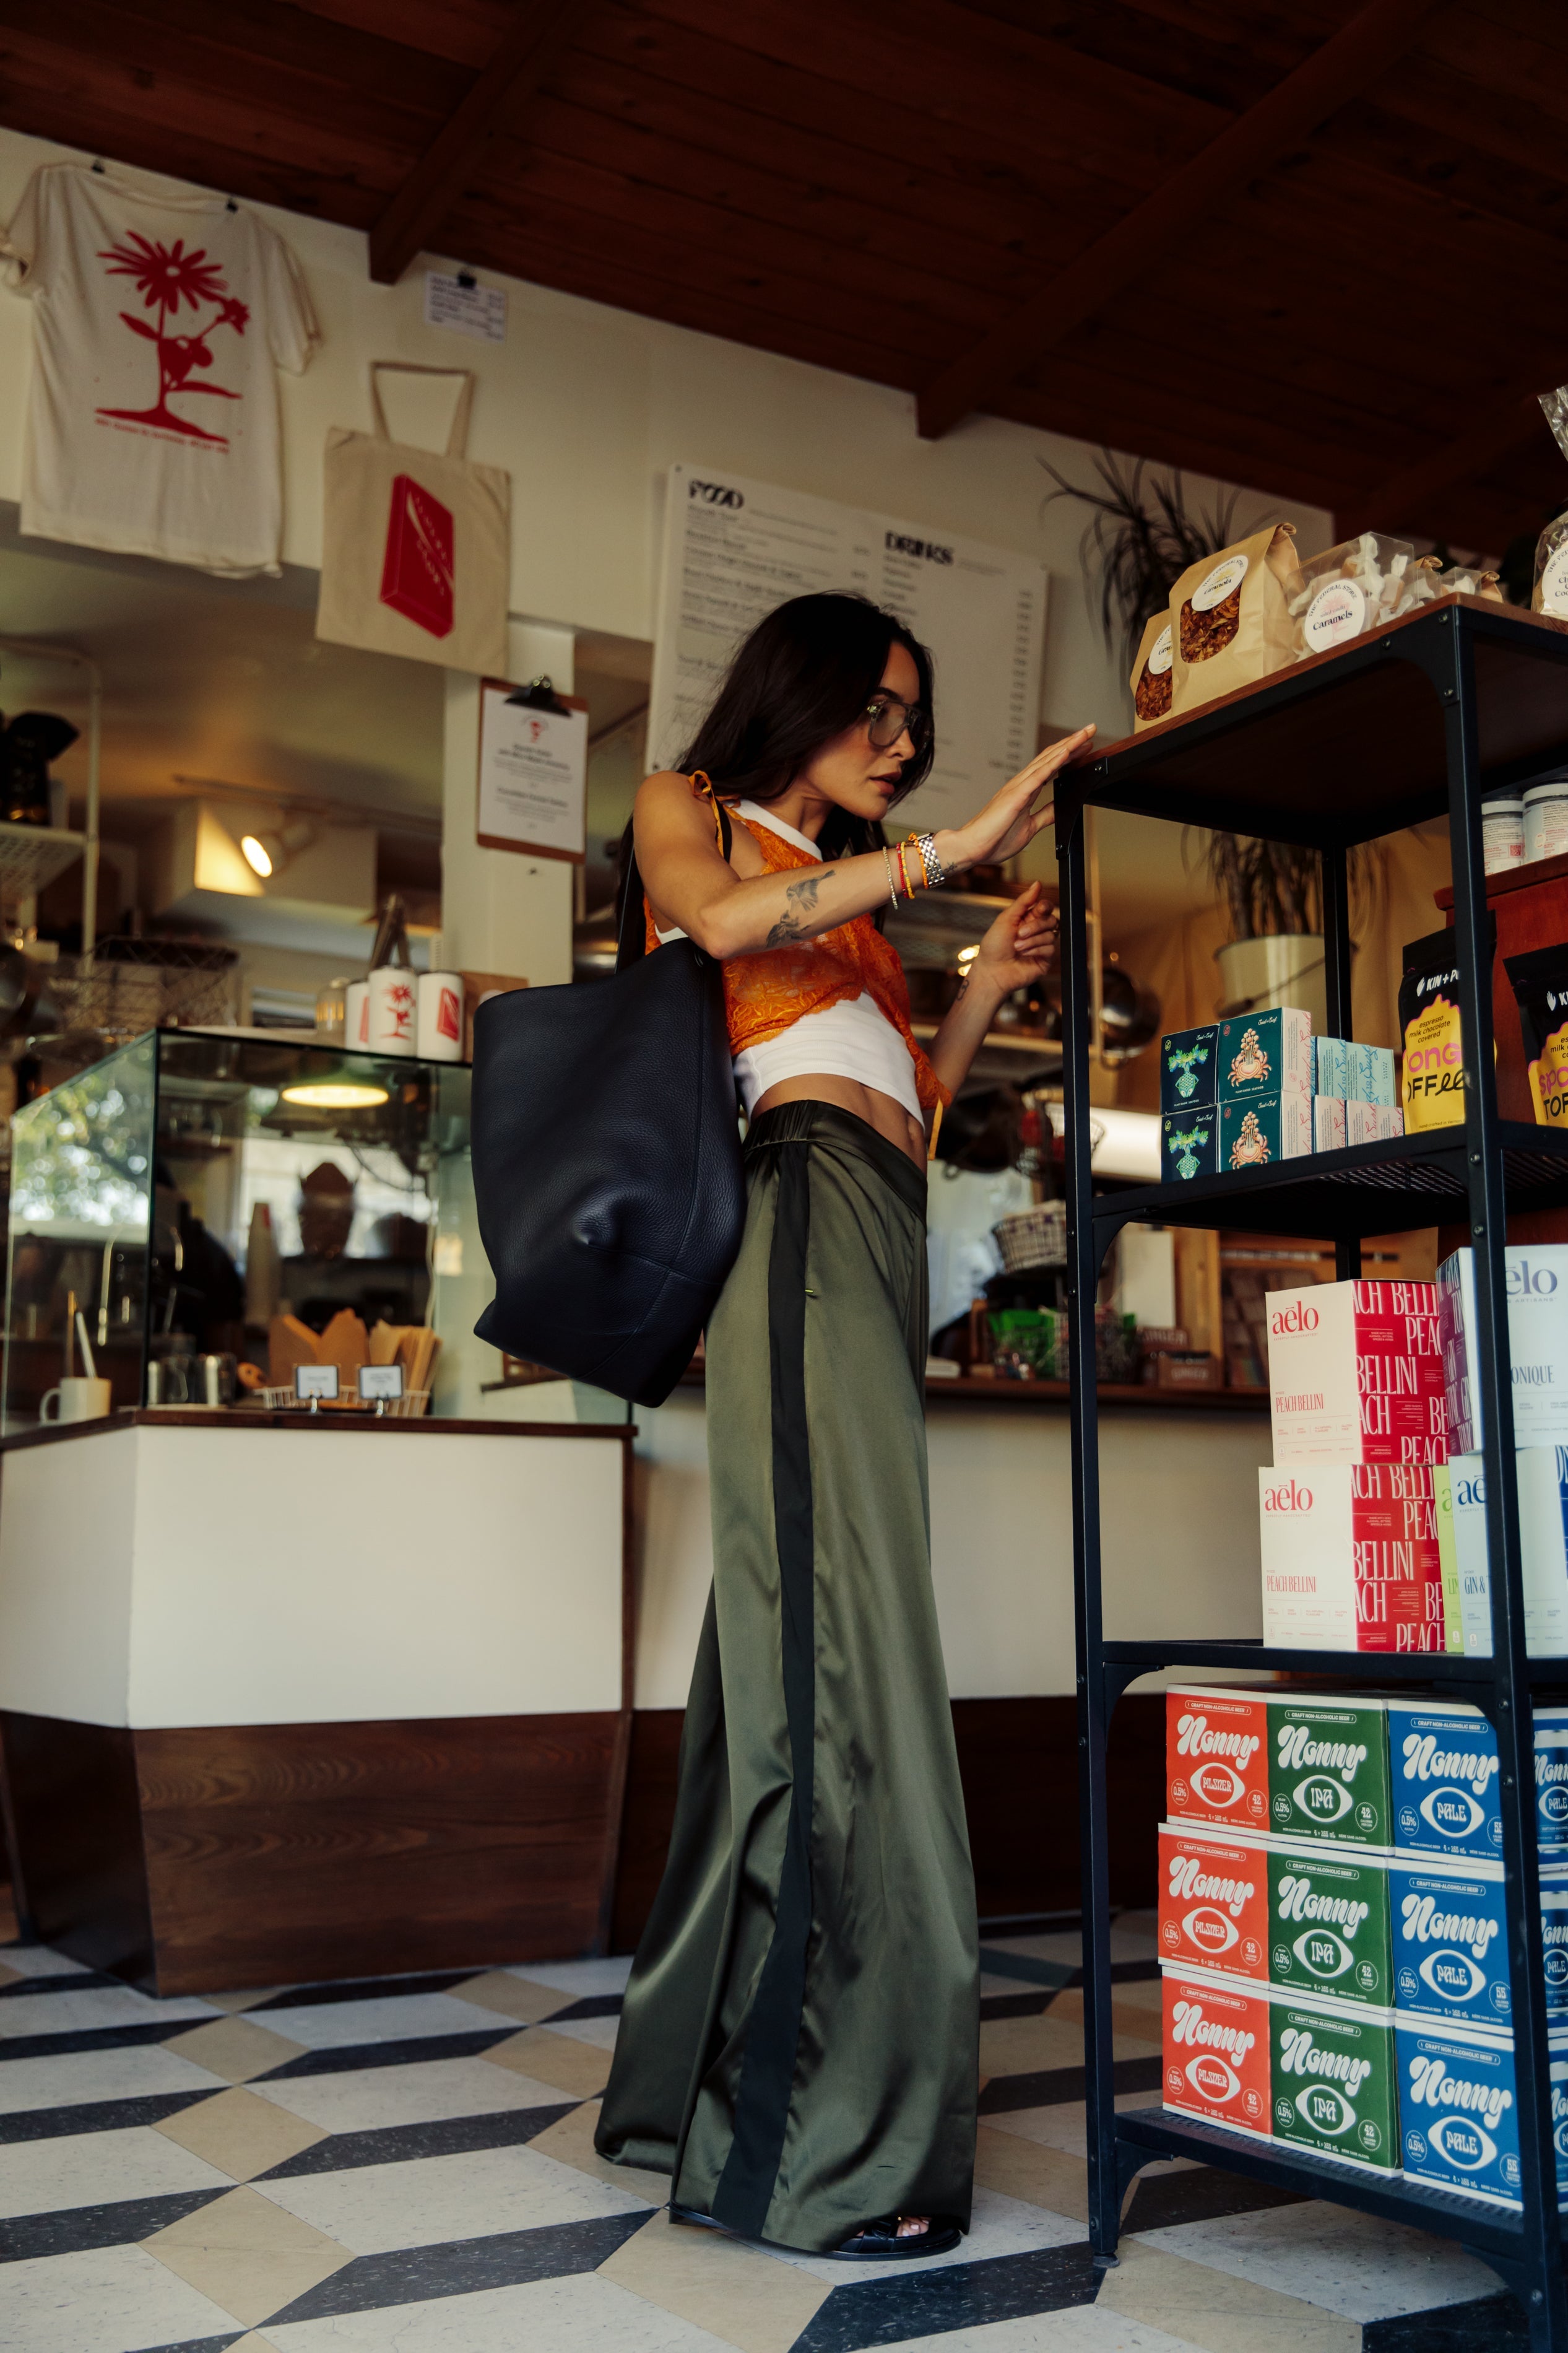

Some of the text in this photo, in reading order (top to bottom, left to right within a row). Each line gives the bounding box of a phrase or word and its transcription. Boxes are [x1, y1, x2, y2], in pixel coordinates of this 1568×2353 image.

[689, 481, 745, 510] FOOD
[885, 531, 954, 565] DRINKS
[1317, 585, 1341, 603] FEDERAL
[1343, 585, 1357, 599] STORE
[1313, 611, 1353, 630] Caramels
[1426, 975, 1442, 991] KIN
[1410, 1020, 1450, 1038] milk chocolate
[1419, 1016, 1444, 1028] espresso
[1418, 1030, 1440, 1043] covered
[1550, 1043, 1564, 1053] milk
[1505, 1260, 1557, 1295] ēlo
[1352, 1281, 1439, 1316] ACH BELLI
[1272, 1301, 1319, 1334] aēlo
[1406, 1317, 1442, 1355] PEAC
[1355, 1355, 1418, 1394] BELLINI
[1511, 1365, 1554, 1386] ONIQUE
[1276, 1393, 1323, 1412] PEACH BELLINI
[1358, 1395, 1390, 1434] ACH
[1351, 1465, 1434, 1499] ACH BELLI
[1264, 1479, 1313, 1511] aēlo
[1353, 1541, 1414, 1580] BELLINI
[1267, 1575, 1316, 1592] PEACH BELLINI
[1465, 1577, 1478, 1595] GIN
[1354, 1582, 1386, 1622] ACH
[1177, 1715, 1259, 1770] Nonny
[1278, 1725, 1366, 1782] Nonny
[1403, 1734, 1500, 1795] Nonny
[1174, 1786, 1186, 1797] 0.5%
[1203, 1777, 1232, 1792] PILSNER
[1252, 1794, 1261, 1805] 42
[1275, 1802, 1289, 1812] 0.5%
[1311, 1788, 1333, 1809] IPA
[1548, 1797, 1567, 1810] PALE
[1361, 1807, 1371, 1818] 42
[1401, 1815, 1416, 1826] 0.5%
[1437, 1802, 1466, 1822] PALE
[1197, 1846, 1228, 1856] NON-ALCOHOLIC
[1307, 1865, 1340, 1874] NON-ALCOHOLIC
[1169, 1856, 1254, 1916] Nonny
[1431, 1882, 1466, 1891] NON-ALCOHOLIC
[1278, 1876, 1368, 1939] Nonny
[1165, 1928, 1179, 1939] 0.5%
[1195, 1921, 1225, 1938] PILSNER
[1401, 1894, 1498, 1959] Nonny
[1246, 1942, 1255, 1953] 42
[1312, 1941, 1333, 1964] IPA
[1275, 1952, 1289, 1964] 0.5%
[1548, 1960, 1566, 1973] PALE
[1362, 1965, 1371, 1977] 42
[1437, 1964, 1468, 1986] PALE
[1401, 1976, 1416, 1988] 0.5%
[1200, 1992, 1230, 2004] NON-ALCOHOLIC
[1309, 2018, 1343, 2030] NON-ALCOHOLIC
[1173, 2001, 1255, 2067] Nonny
[1425, 2043, 1440, 2051] CRAFT
[1441, 2046, 1479, 2059] NON-ALCOHOLIC
[1280, 2028, 1371, 2097] Nonny
[1169, 2074, 1182, 2086] 0.5%
[1198, 2068, 1227, 2088] PILSNER
[1248, 2093, 1257, 2105] 42
[1409, 2056, 1512, 2129] Nonny
[1278, 2106, 1292, 2118] 0.5%
[1314, 2097, 1336, 2121] IPA
[1364, 2125, 1374, 2137] 42
[1408, 2139, 1424, 2153] 0.5%
[1446, 2131, 1478, 2155] PALE
